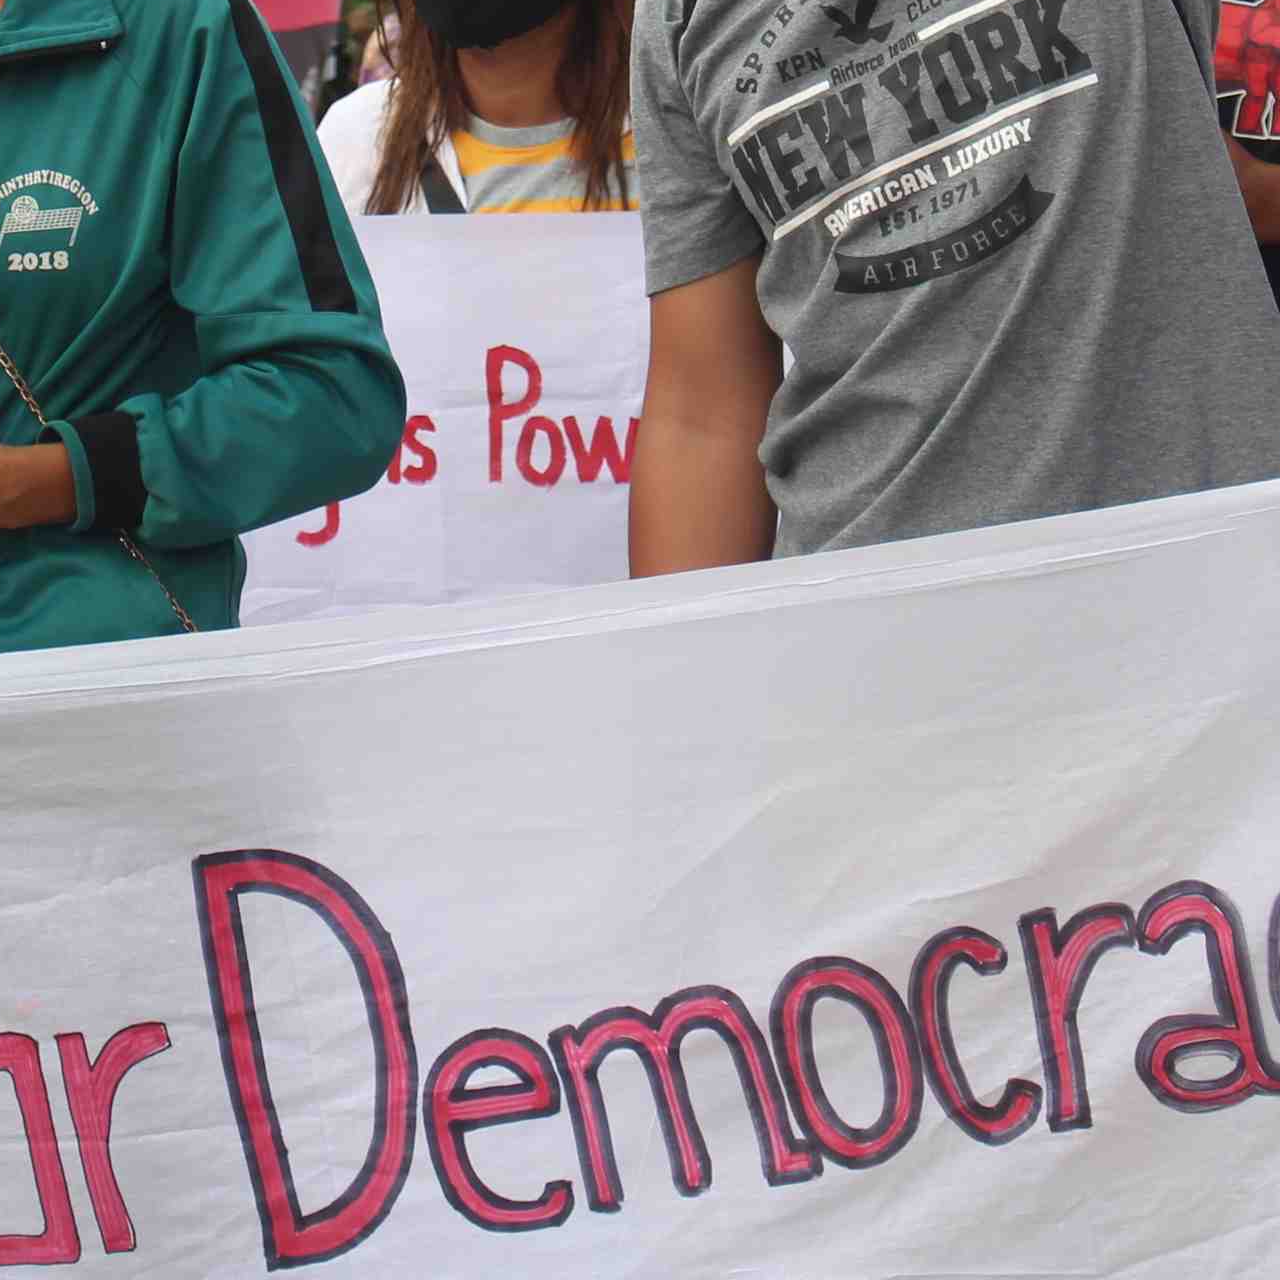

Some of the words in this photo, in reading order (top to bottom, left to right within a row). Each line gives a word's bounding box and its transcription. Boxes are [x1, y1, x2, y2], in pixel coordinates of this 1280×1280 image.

[775, 47, 827, 84] KPN
[830, 53, 885, 87] Airforce
[888, 31, 921, 61] team
[732, 83, 876, 226] NEW
[823, 163, 938, 238] AMERICAN
[942, 117, 1033, 178] LUXURY
[878, 208, 924, 238] EST.
[929, 176, 982, 214] 1971
[7, 249, 70, 272] 2018
[863, 256, 920, 287] AIR
[928, 206, 1030, 272] FORCE
